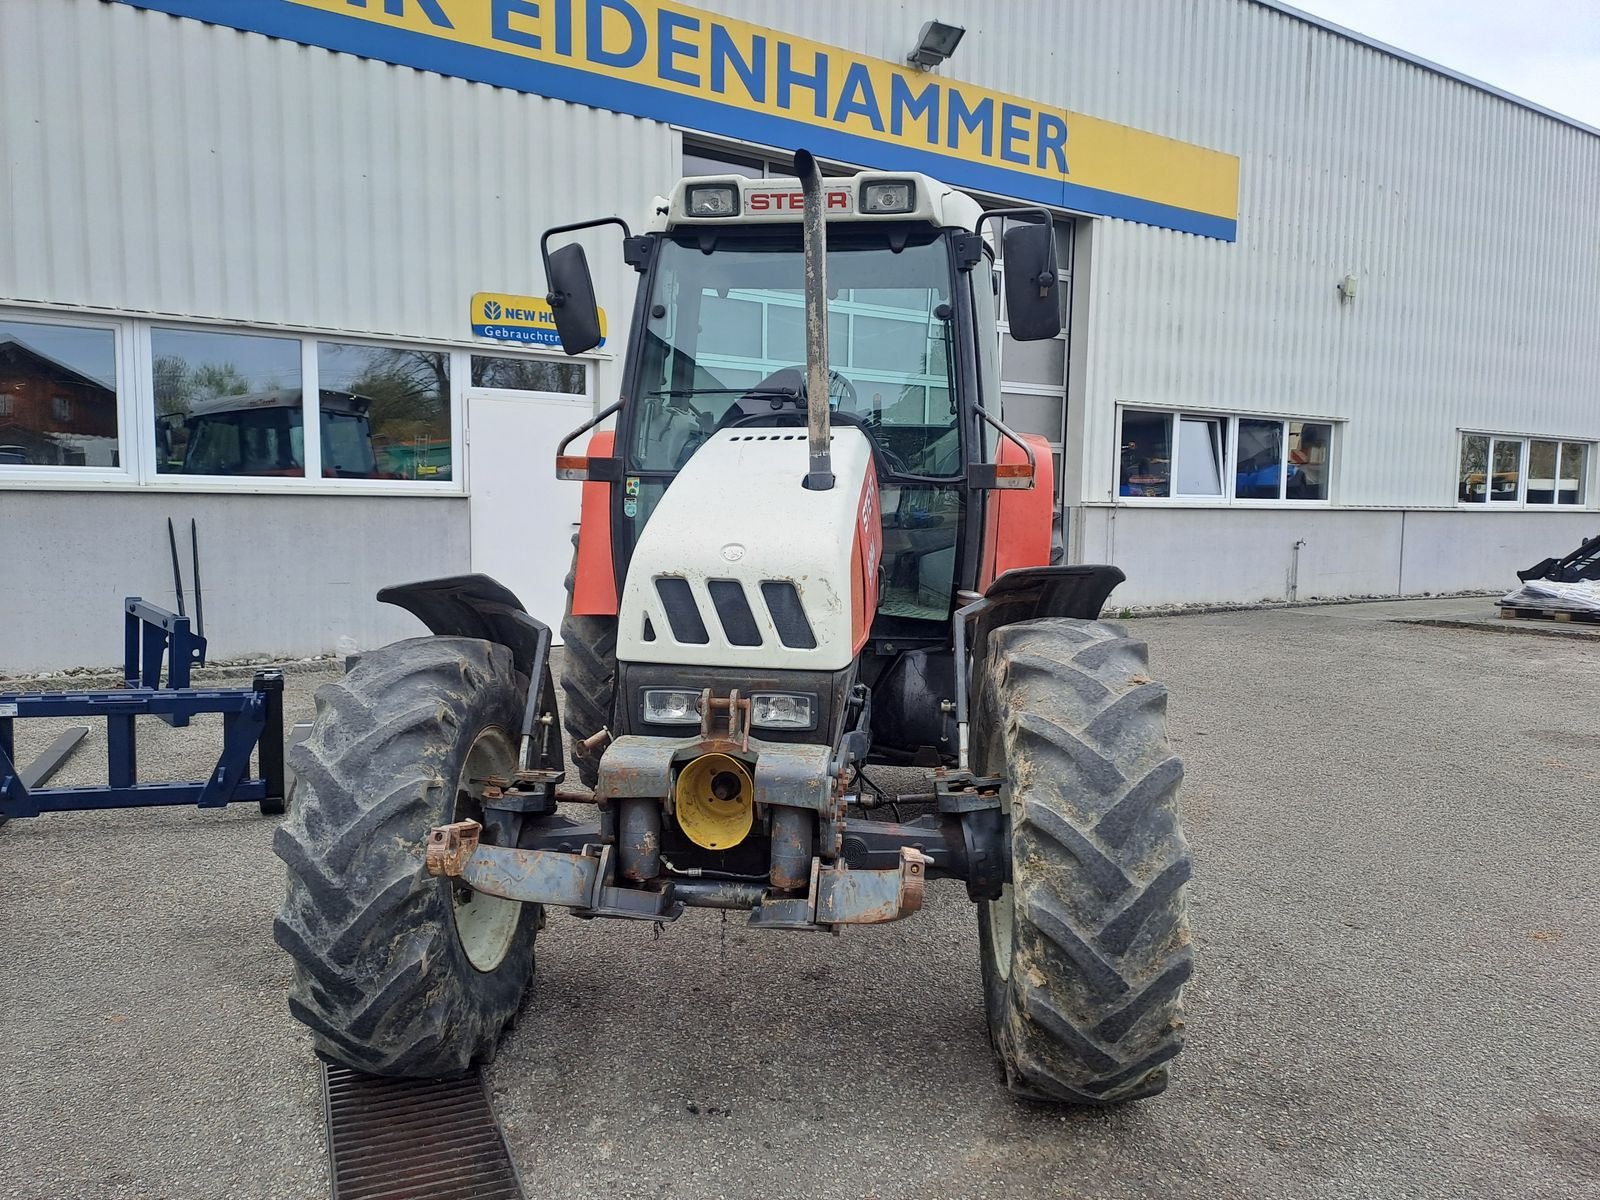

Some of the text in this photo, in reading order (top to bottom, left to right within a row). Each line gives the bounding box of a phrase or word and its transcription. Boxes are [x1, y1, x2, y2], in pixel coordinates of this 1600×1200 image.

[491, 0, 1069, 174] EIDENHAMMER
[751, 192, 847, 209] STER
[505, 308, 535, 321] NEW
